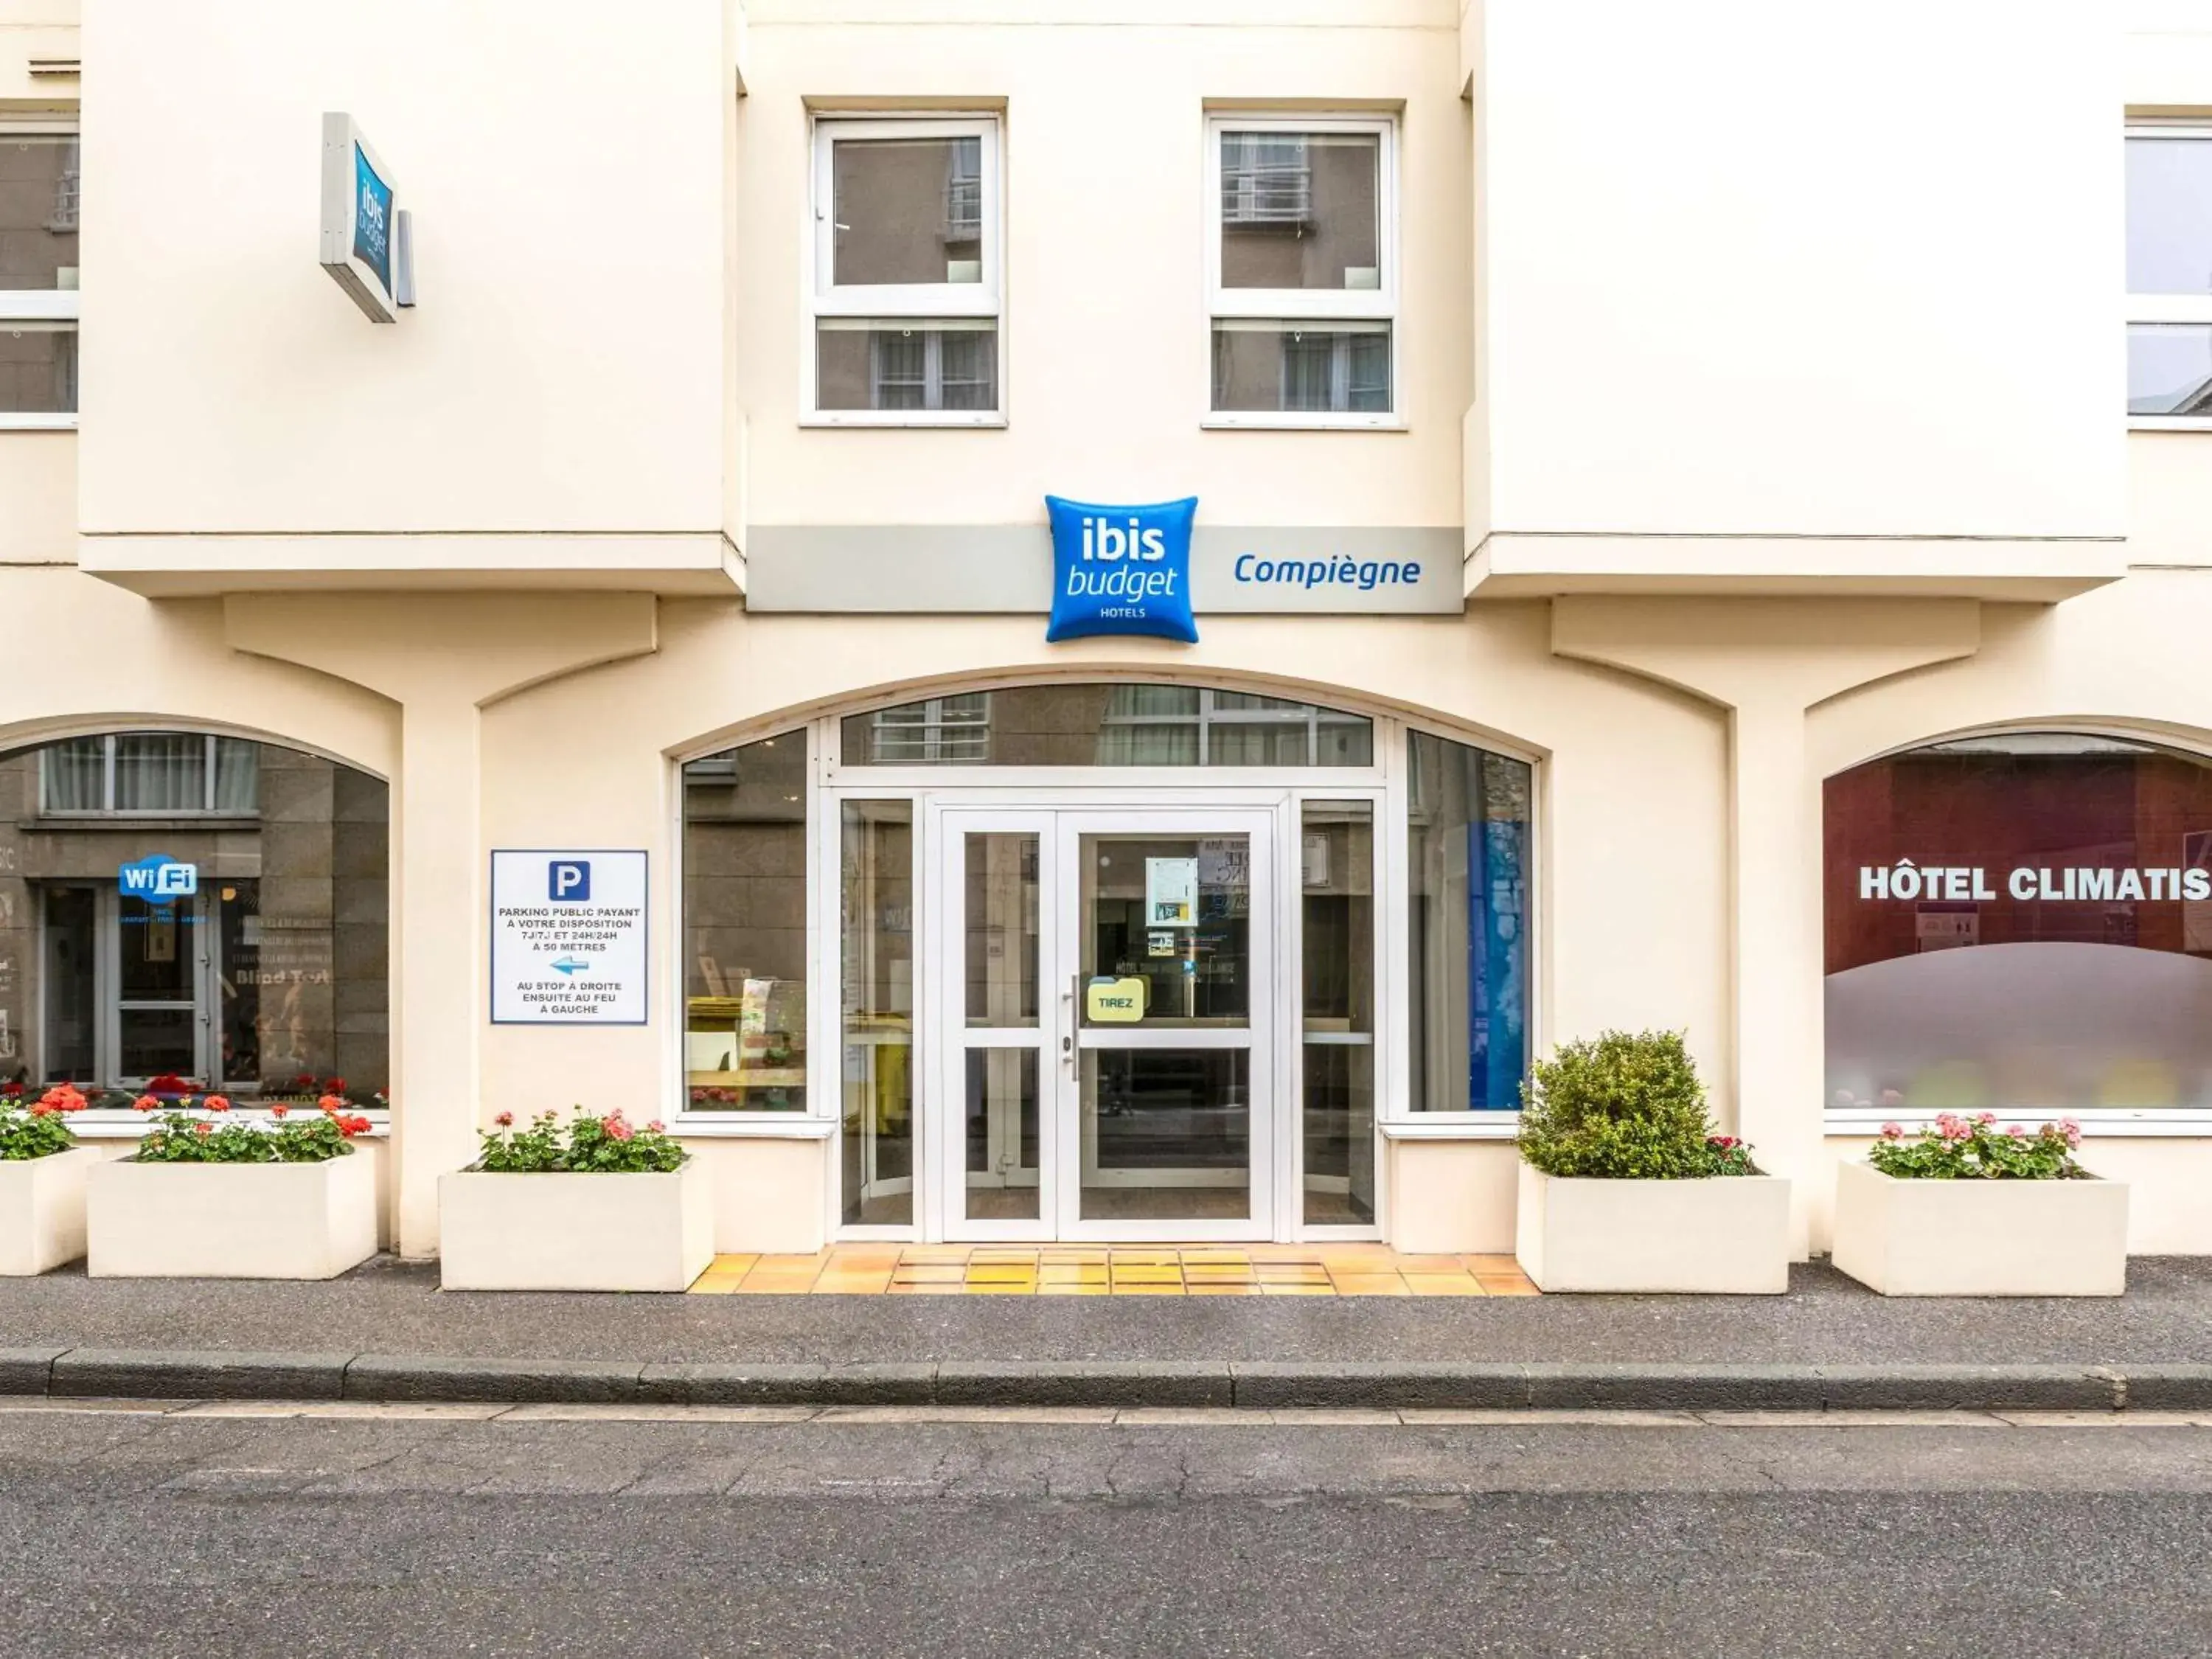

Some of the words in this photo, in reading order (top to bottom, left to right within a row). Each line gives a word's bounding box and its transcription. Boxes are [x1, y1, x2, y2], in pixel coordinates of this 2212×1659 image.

[363, 177, 383, 231] ibis
[1082, 518, 1165, 561] ibis
[1234, 554, 1421, 590] Compiègne
[1067, 564, 1178, 603] budget
[1100, 607, 1146, 618] HOTELS
[557, 866, 582, 896] P
[1860, 858, 1996, 900] HÔTEL
[2008, 867, 2211, 900] CLIMATIS
[498, 908, 549, 917] PARKING
[552, 908, 594, 917] PUBLIC
[597, 908, 641, 917] PAYANT
[518, 919, 556, 928] VOTRE
[559, 919, 632, 928] DISPOSITION
[554, 931, 568, 939] ET
[571, 931, 618, 940] 24H/24H
[543, 943, 557, 951] 50
[517, 982, 533, 990] AU
[536, 982, 566, 990] STOP
[580, 982, 622, 990] DROITE
[523, 994, 571, 1002] ENSUITE
[574, 994, 591, 1002] AU
[594, 994, 616, 1002] FEU
[1099, 998, 1133, 1008] TIREZ
[552, 1005, 599, 1014] GAUCHE
